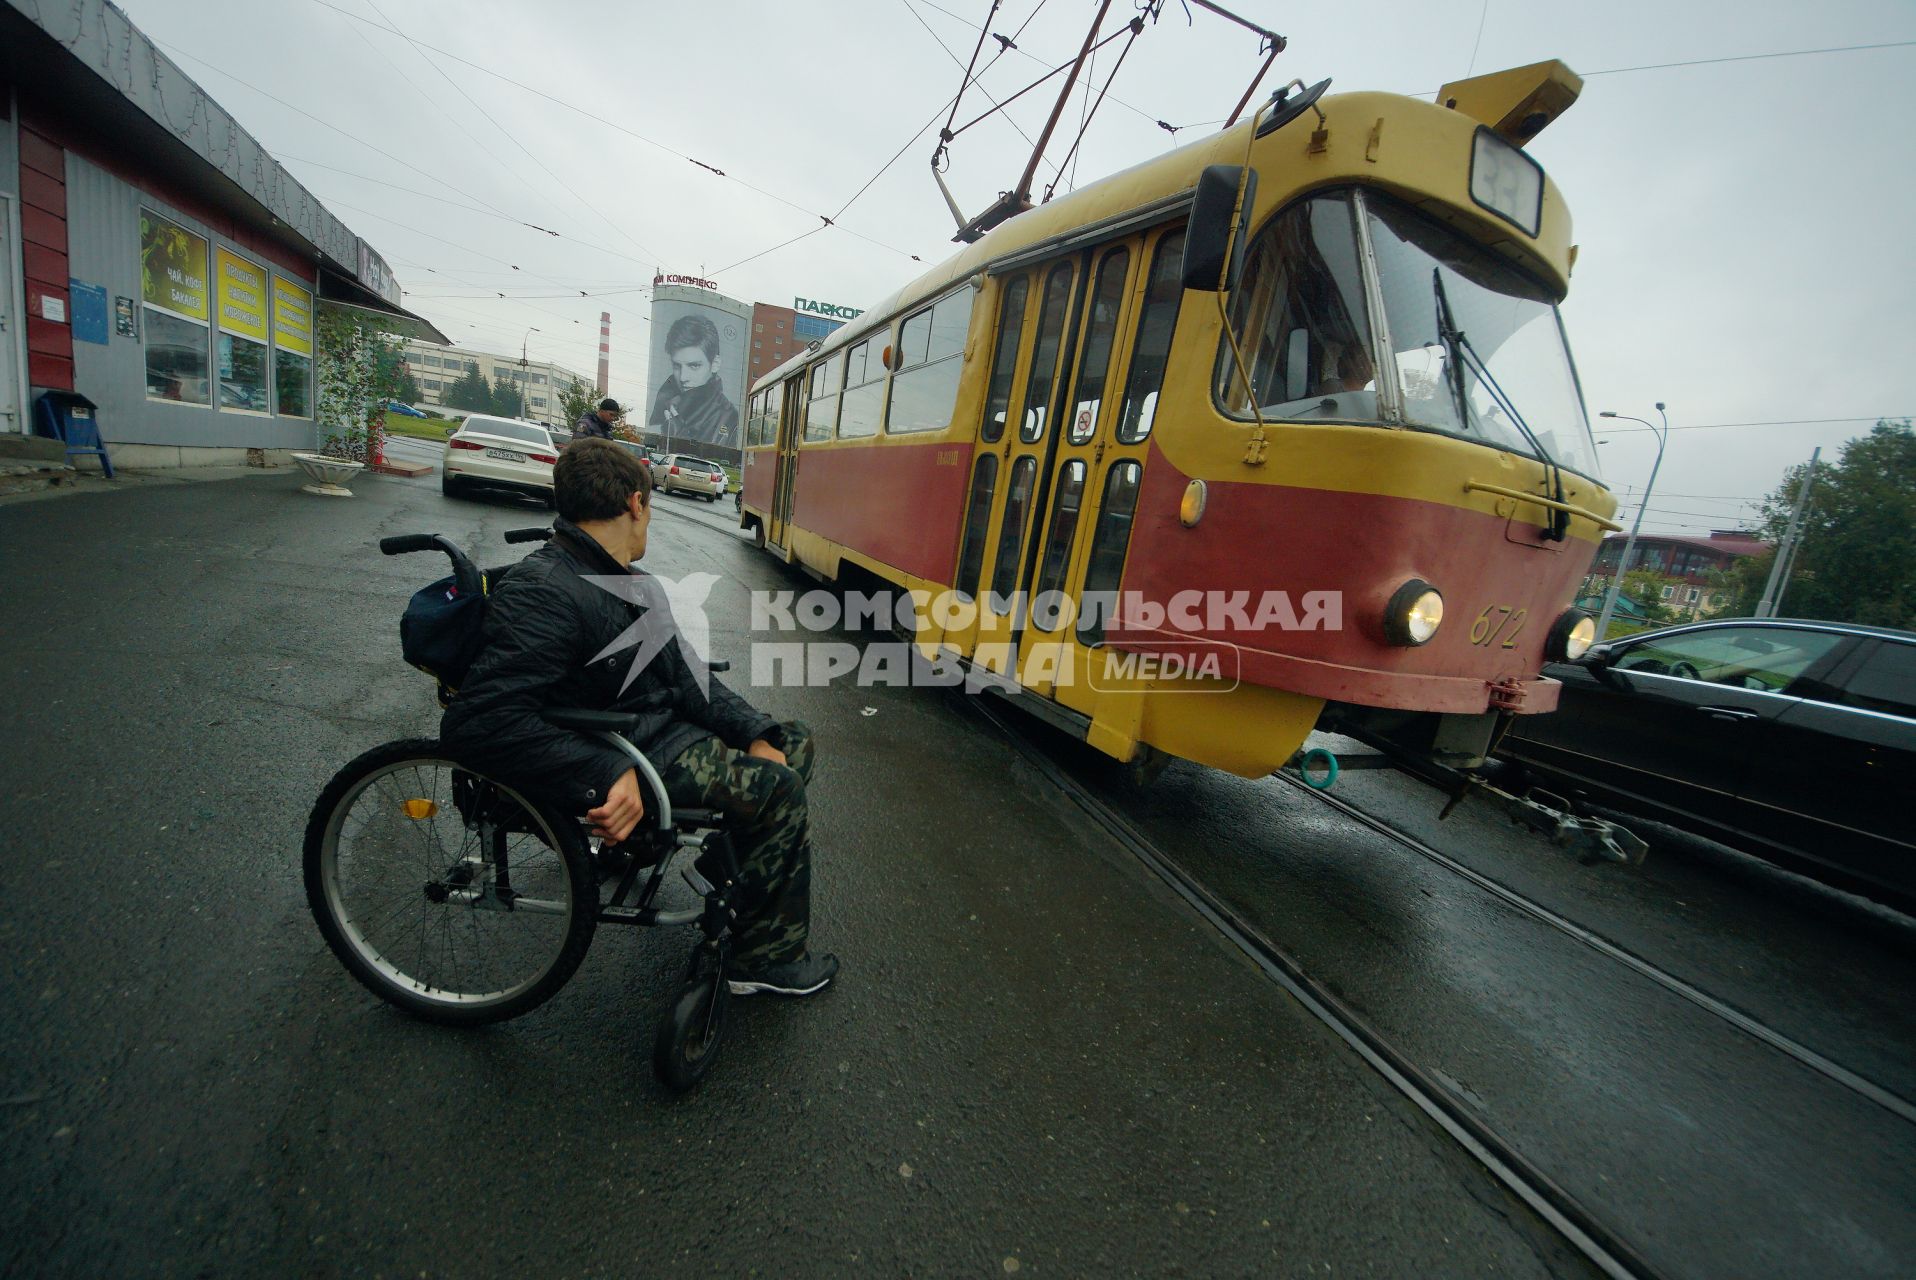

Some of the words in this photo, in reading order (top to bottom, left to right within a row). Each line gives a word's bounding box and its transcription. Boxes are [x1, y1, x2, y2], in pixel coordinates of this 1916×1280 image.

[225, 262, 258, 289] ПРОДУКТЫ
[666, 274, 718, 290] КОМПЛЕКС
[171, 288, 201, 309] БАКАЛЕЯ
[1471, 603, 1528, 649] 672
